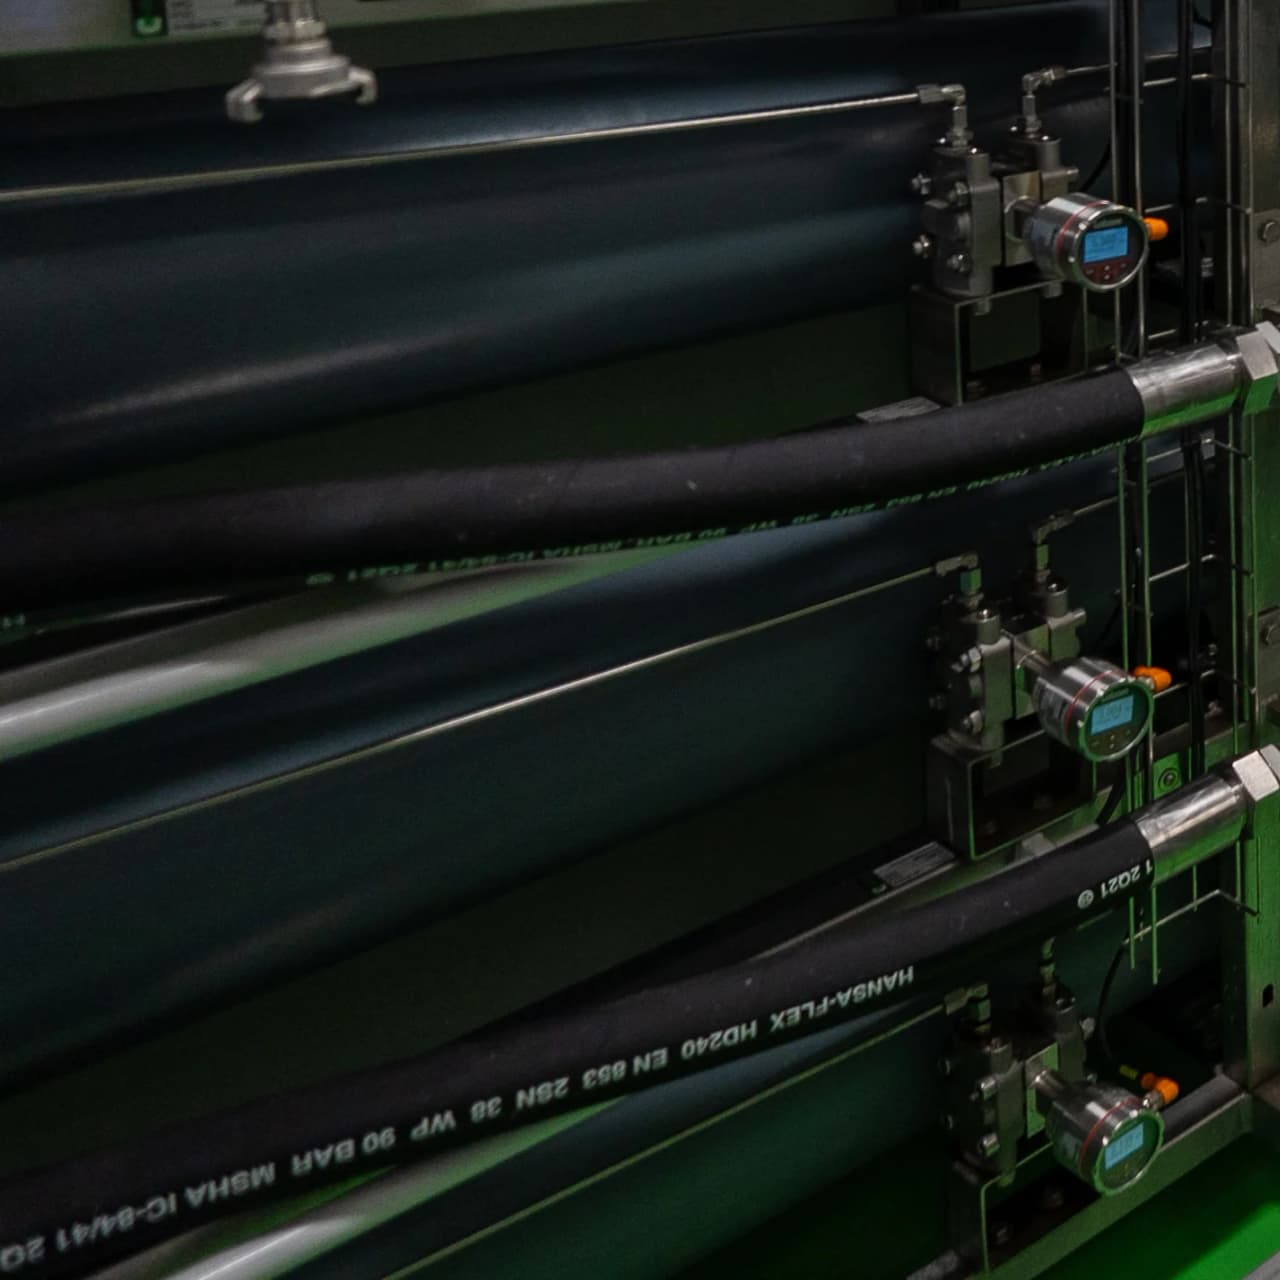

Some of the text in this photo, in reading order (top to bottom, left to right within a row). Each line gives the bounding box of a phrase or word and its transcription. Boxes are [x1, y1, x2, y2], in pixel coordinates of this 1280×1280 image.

[1099, 864, 1142, 899] 2Q21
[769, 965, 915, 1032] HANSA-FLEX
[680, 1021, 757, 1058] HD240
[582, 1062, 627, 1092] 853
[632, 1048, 668, 1075] EN
[470, 1097, 503, 1123] 38
[515, 1079, 571, 1110] 2SN
[362, 1126, 396, 1153] 90
[410, 1111, 456, 1143] WP
[292, 1140, 356, 1175] BAR
[184, 1162, 275, 1210] MSHA
[55, 1195, 177, 1252] IC-84/41
